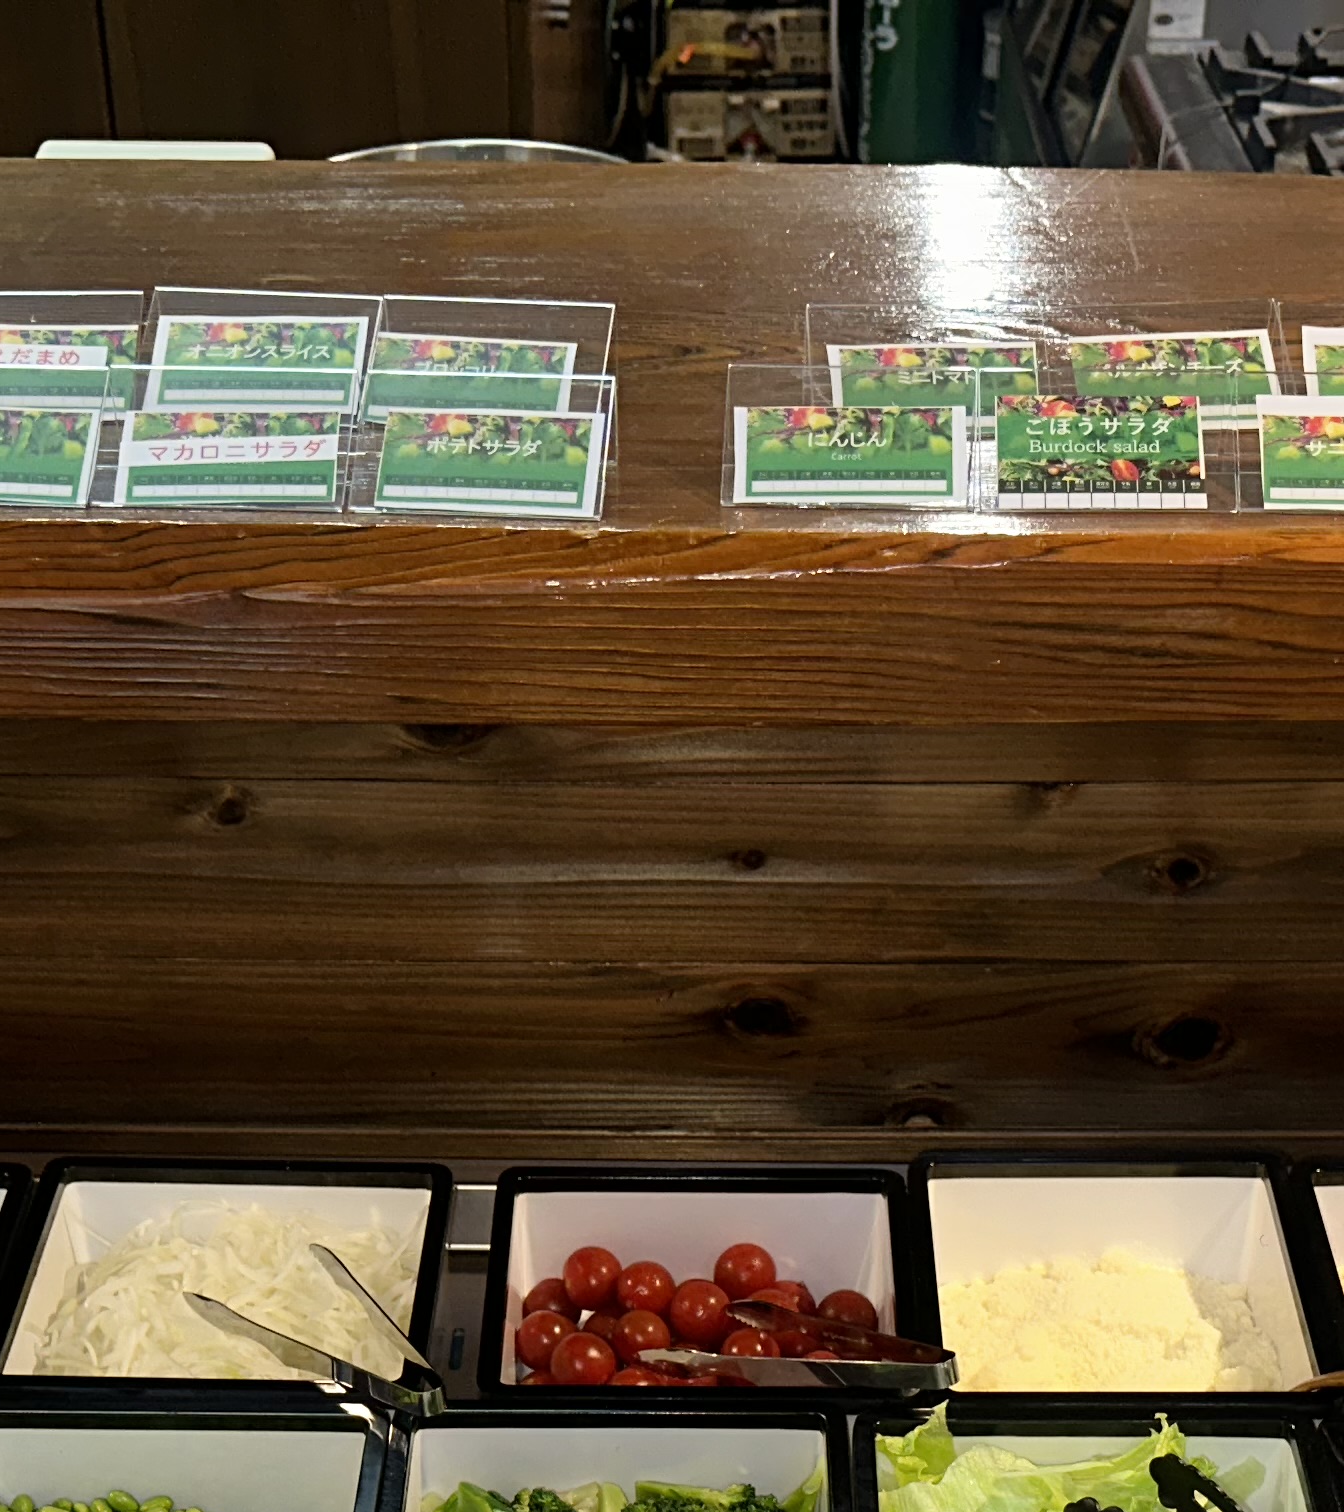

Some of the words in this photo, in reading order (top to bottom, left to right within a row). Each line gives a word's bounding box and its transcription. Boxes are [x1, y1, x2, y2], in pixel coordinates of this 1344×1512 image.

[187, 344, 331, 360] オニオンスライス
[897, 370, 975, 385] ミニトマト
[1025, 416, 1175, 436] ごぼうサラダ
[426, 438, 543, 457] ポテトサラダ
[807, 430, 887, 448] にんじん
[1029, 439, 1108, 453] Burdock
[1113, 439, 1161, 454] salad
[148, 438, 327, 462] マカロニサラダ
[831, 452, 863, 461] Carrot
